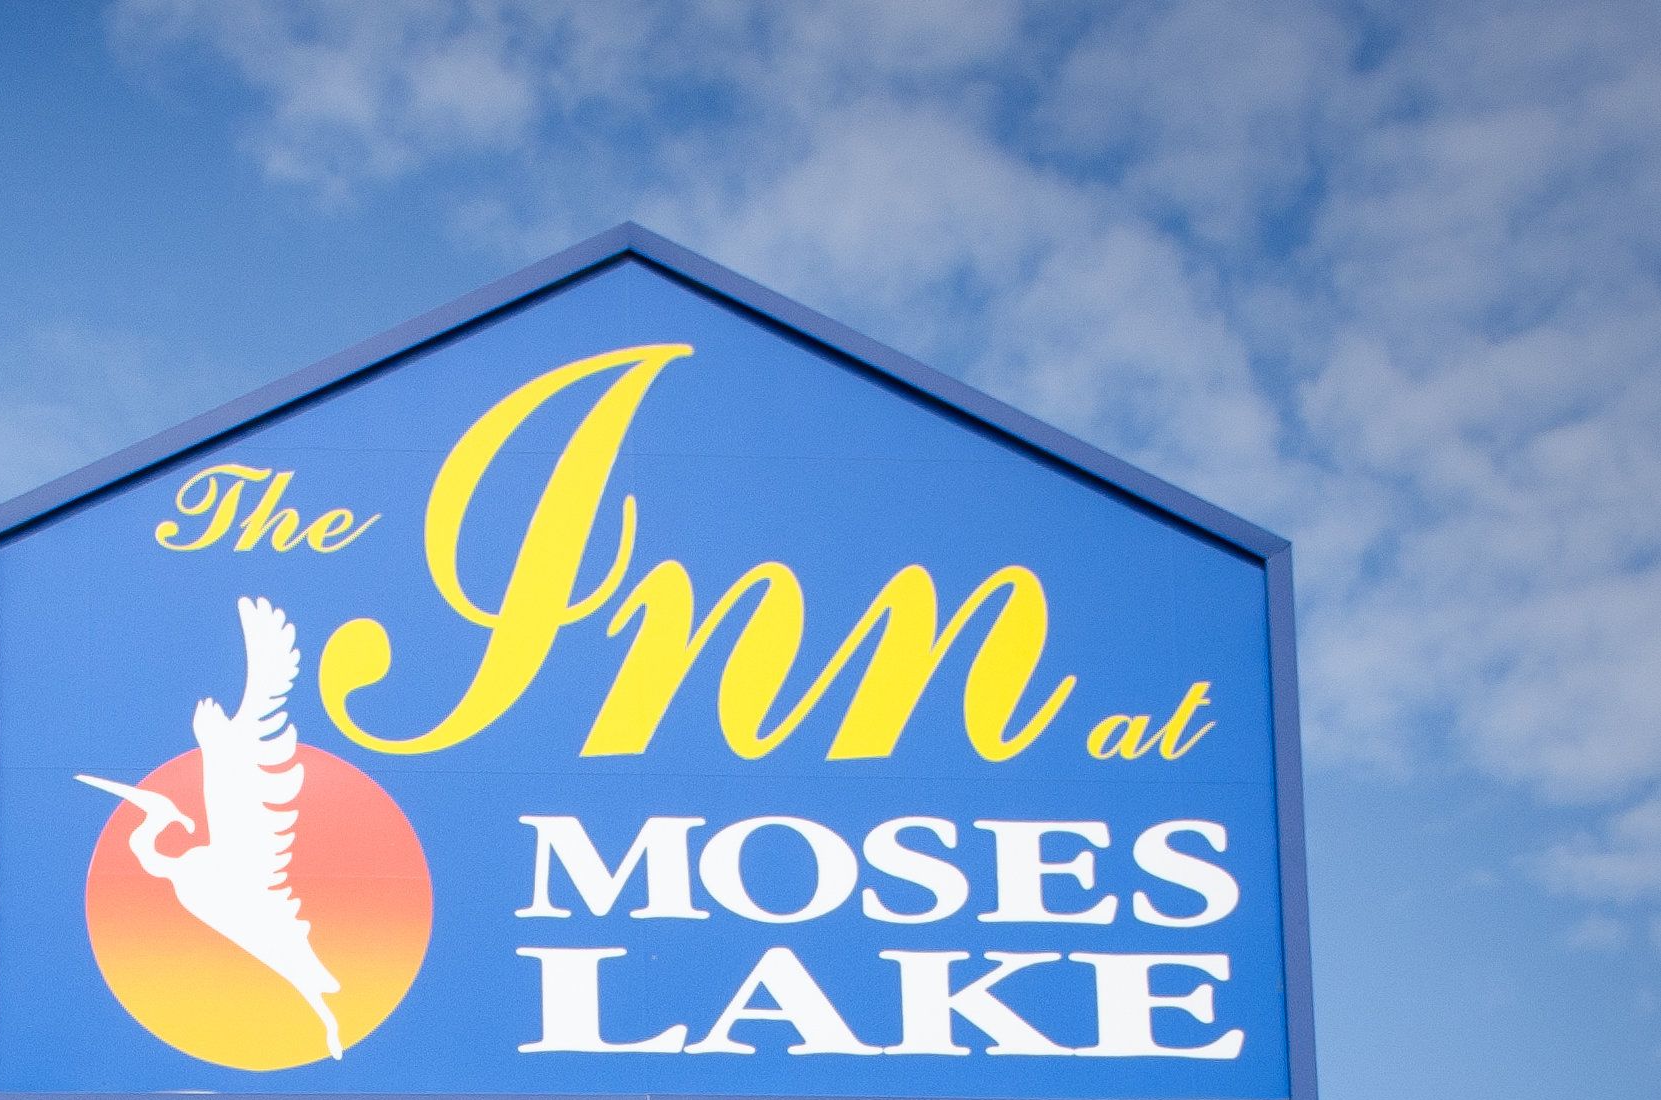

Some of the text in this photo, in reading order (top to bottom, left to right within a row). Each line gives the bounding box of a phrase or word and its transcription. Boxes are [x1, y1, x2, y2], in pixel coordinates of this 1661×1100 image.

[155, 343, 1217, 763] The Inn at
[514, 815, 1240, 928] MOSES
[514, 947, 1245, 1060] LAKE
